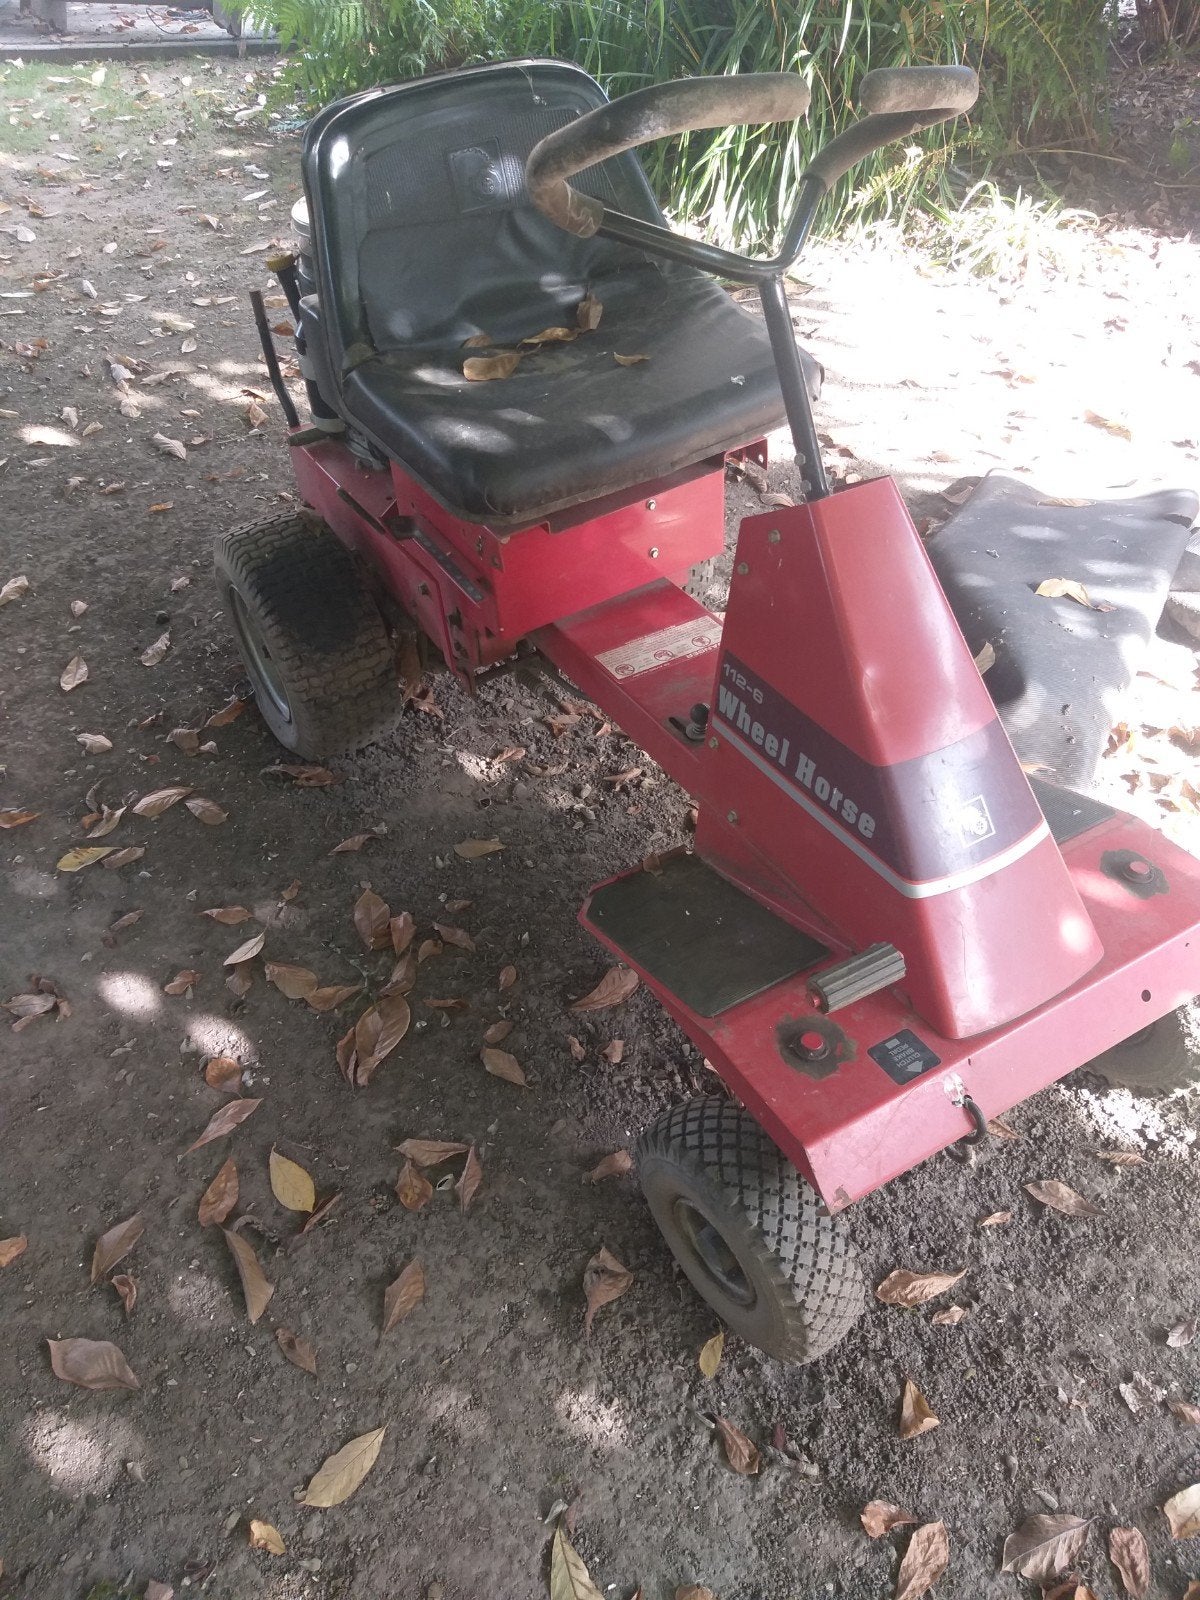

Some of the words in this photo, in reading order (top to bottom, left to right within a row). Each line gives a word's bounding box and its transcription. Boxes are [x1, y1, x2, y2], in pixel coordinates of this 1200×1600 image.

[723, 663, 764, 705] 112-6
[718, 684, 790, 767] Wheel
[794, 751, 876, 839] Horse
[888, 1042, 909, 1056] PEDAL
[894, 1047, 915, 1062] BRAKE
[896, 1052, 921, 1069] CLUTCH
